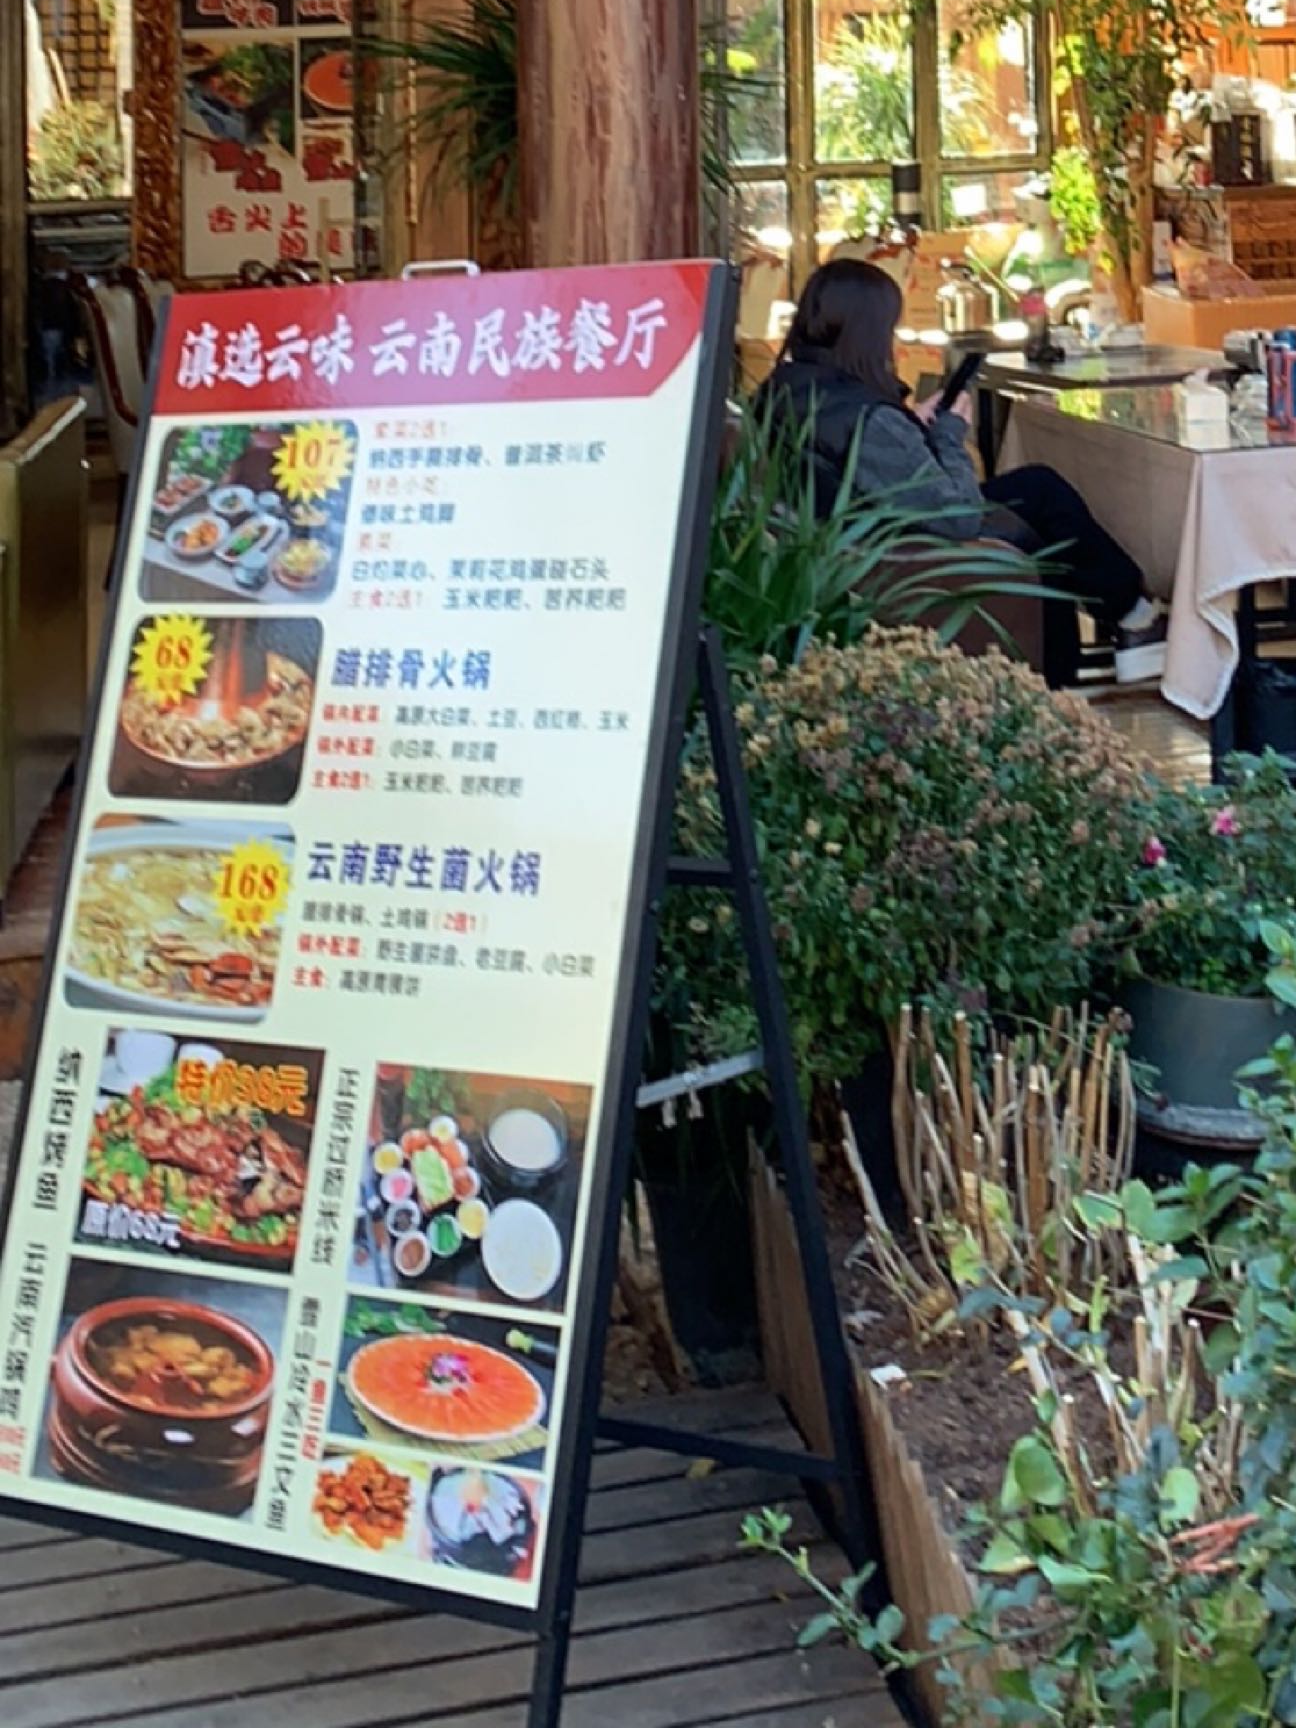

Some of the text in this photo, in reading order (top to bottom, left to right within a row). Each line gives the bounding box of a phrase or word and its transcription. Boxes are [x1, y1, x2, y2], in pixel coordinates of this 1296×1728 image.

[176, 297, 668, 390] 滇选云味 云南民族餐厅
[284, 437, 342, 469] 107
[155, 634, 194, 663] 68
[331, 647, 492, 690] 腊排骨火锅
[221, 863, 279, 900] 168
[306, 840, 543, 897] 云南野生菌火锅
[311, 1067, 360, 1267] 正宗过桥米线
